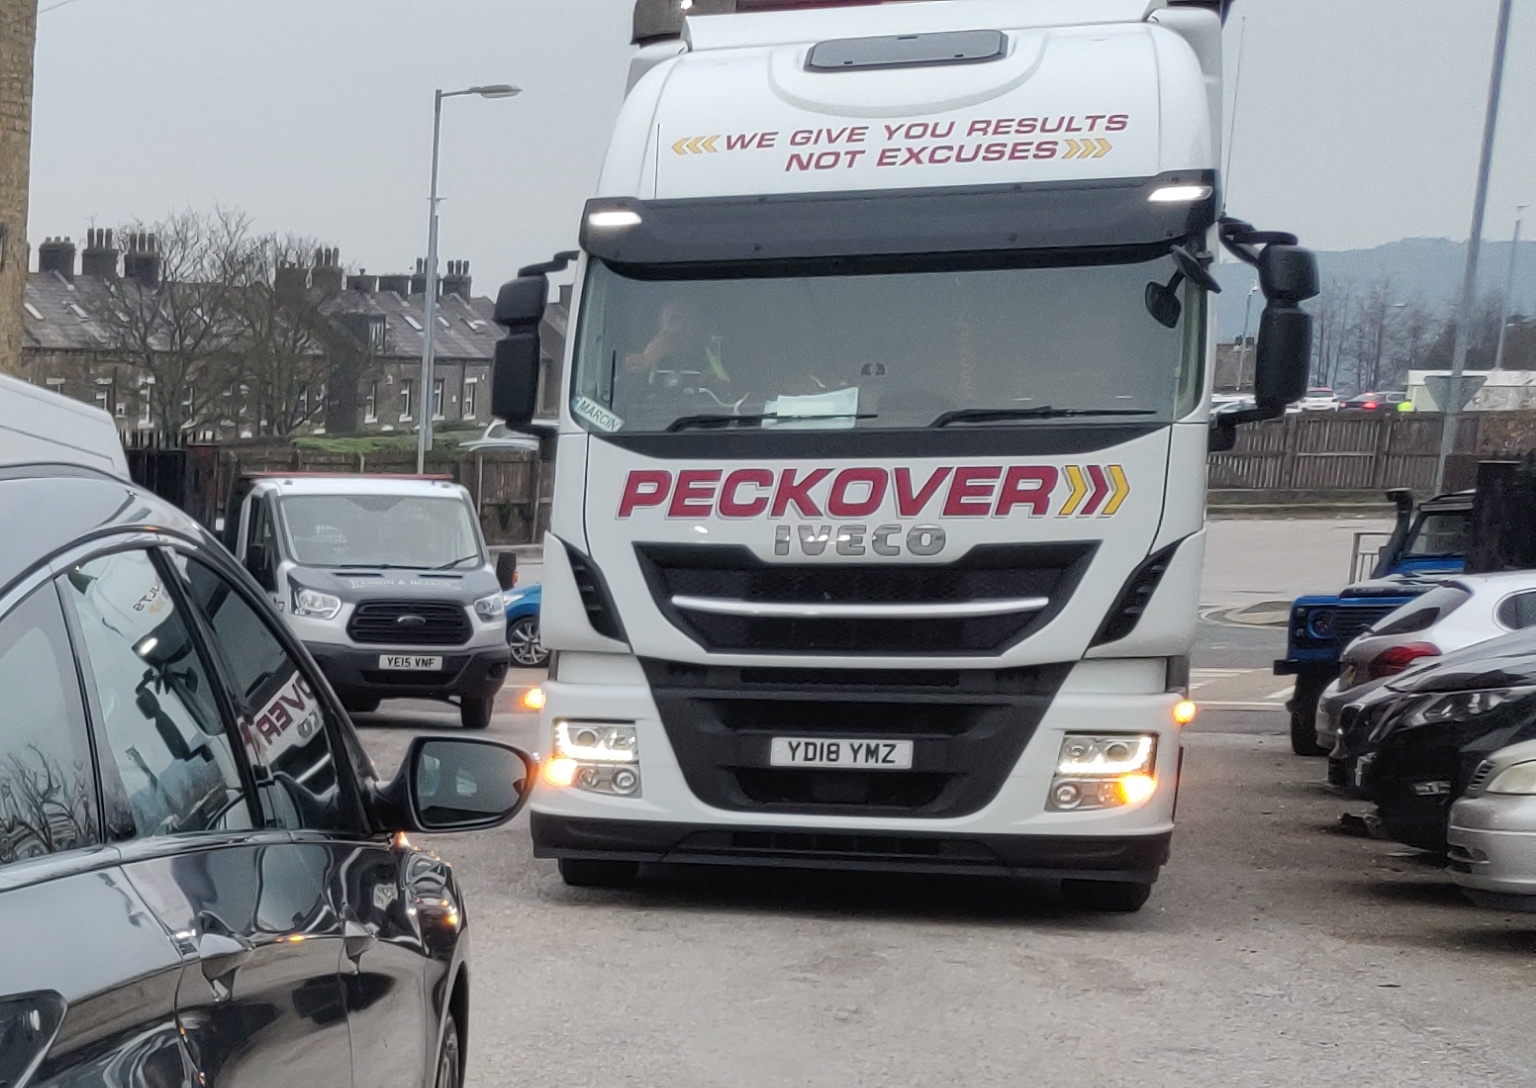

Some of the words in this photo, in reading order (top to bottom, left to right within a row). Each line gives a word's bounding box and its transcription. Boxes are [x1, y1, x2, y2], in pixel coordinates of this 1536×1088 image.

[726, 131, 779, 151] WE
[790, 126, 869, 146] GIVE
[883, 121, 955, 141] YOU
[966, 114, 1129, 138] RESULTS
[785, 150, 865, 173] NOT
[876, 141, 1059, 168] EXCUSES
[616, 465, 1059, 519] PECKOVER
[774, 524, 946, 556] IVECO
[387, 656, 412, 668] YE15
[788, 741, 840, 762] YD18
[850, 743, 897, 764] YMZ
